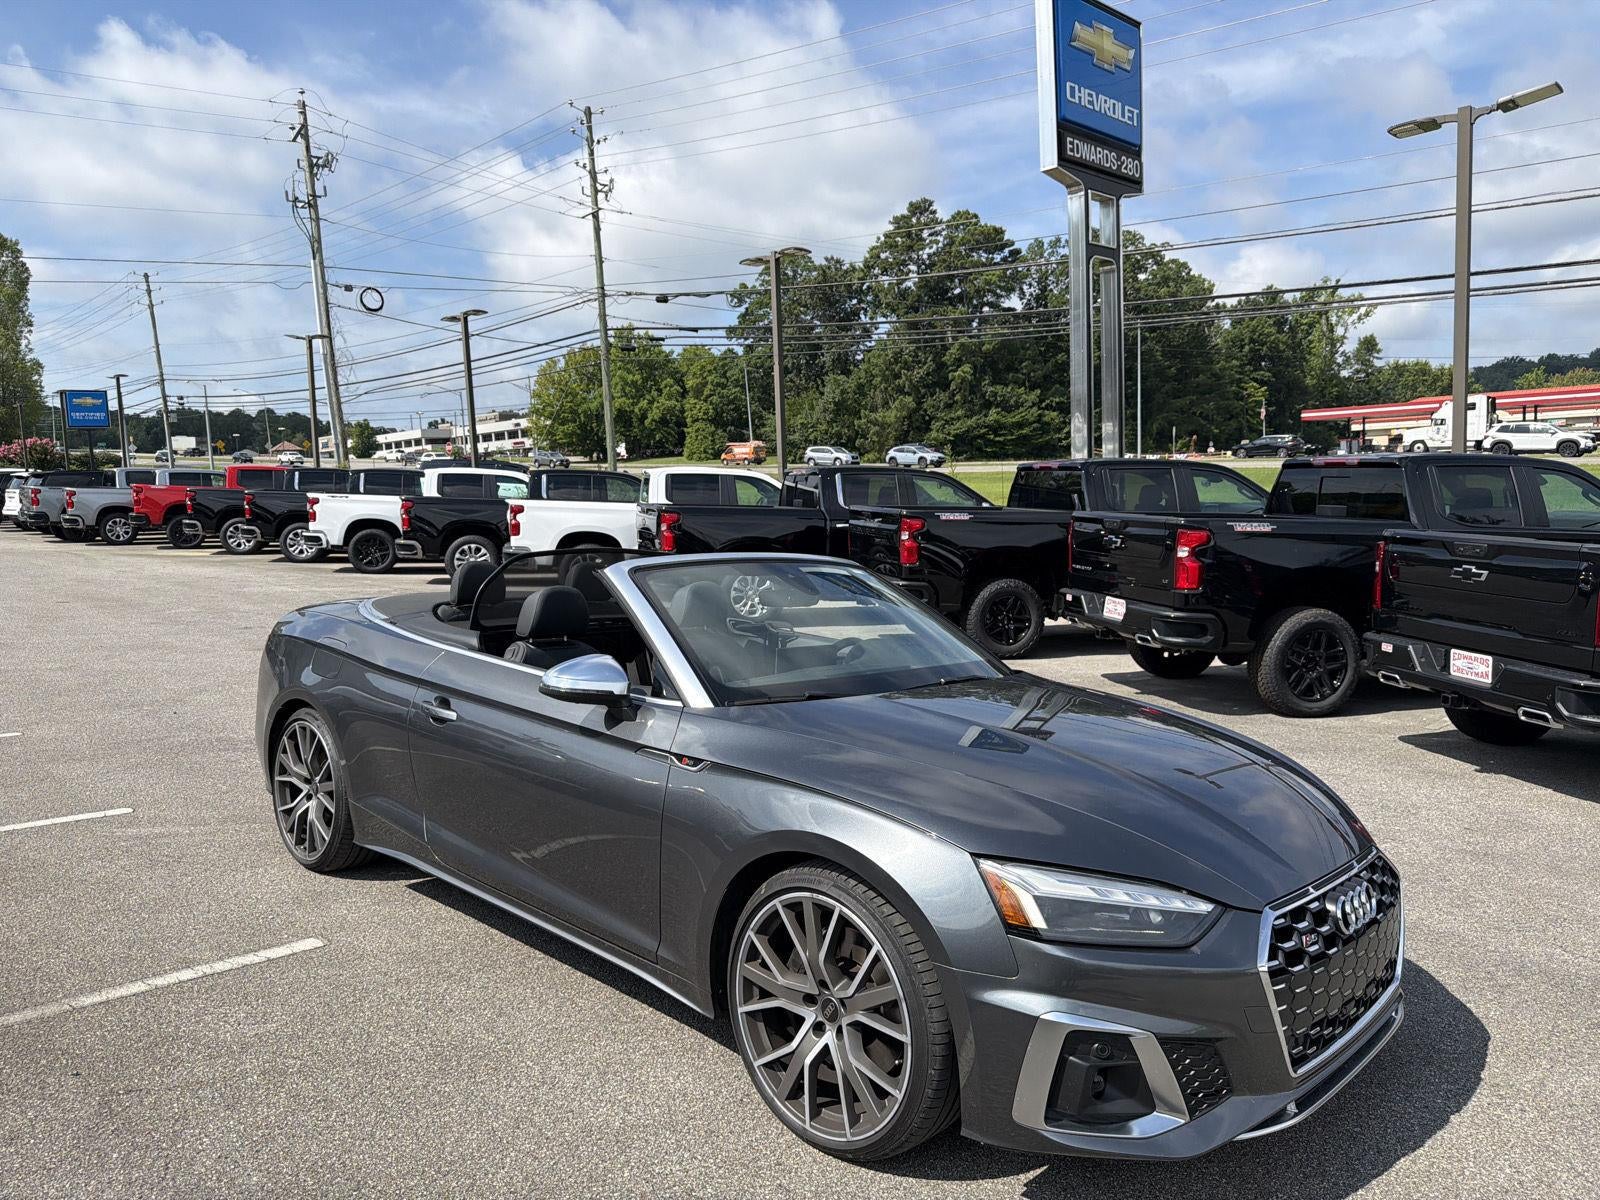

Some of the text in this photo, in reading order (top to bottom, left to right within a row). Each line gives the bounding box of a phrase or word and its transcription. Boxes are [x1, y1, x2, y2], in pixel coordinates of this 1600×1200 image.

[1066, 81, 1139, 126] CHEVROLET
[1066, 136, 1141, 178] EDWARDS-280
[1452, 652, 1490, 669] EDWARDS
[1452, 663, 1490, 680] CHEVYMAN
